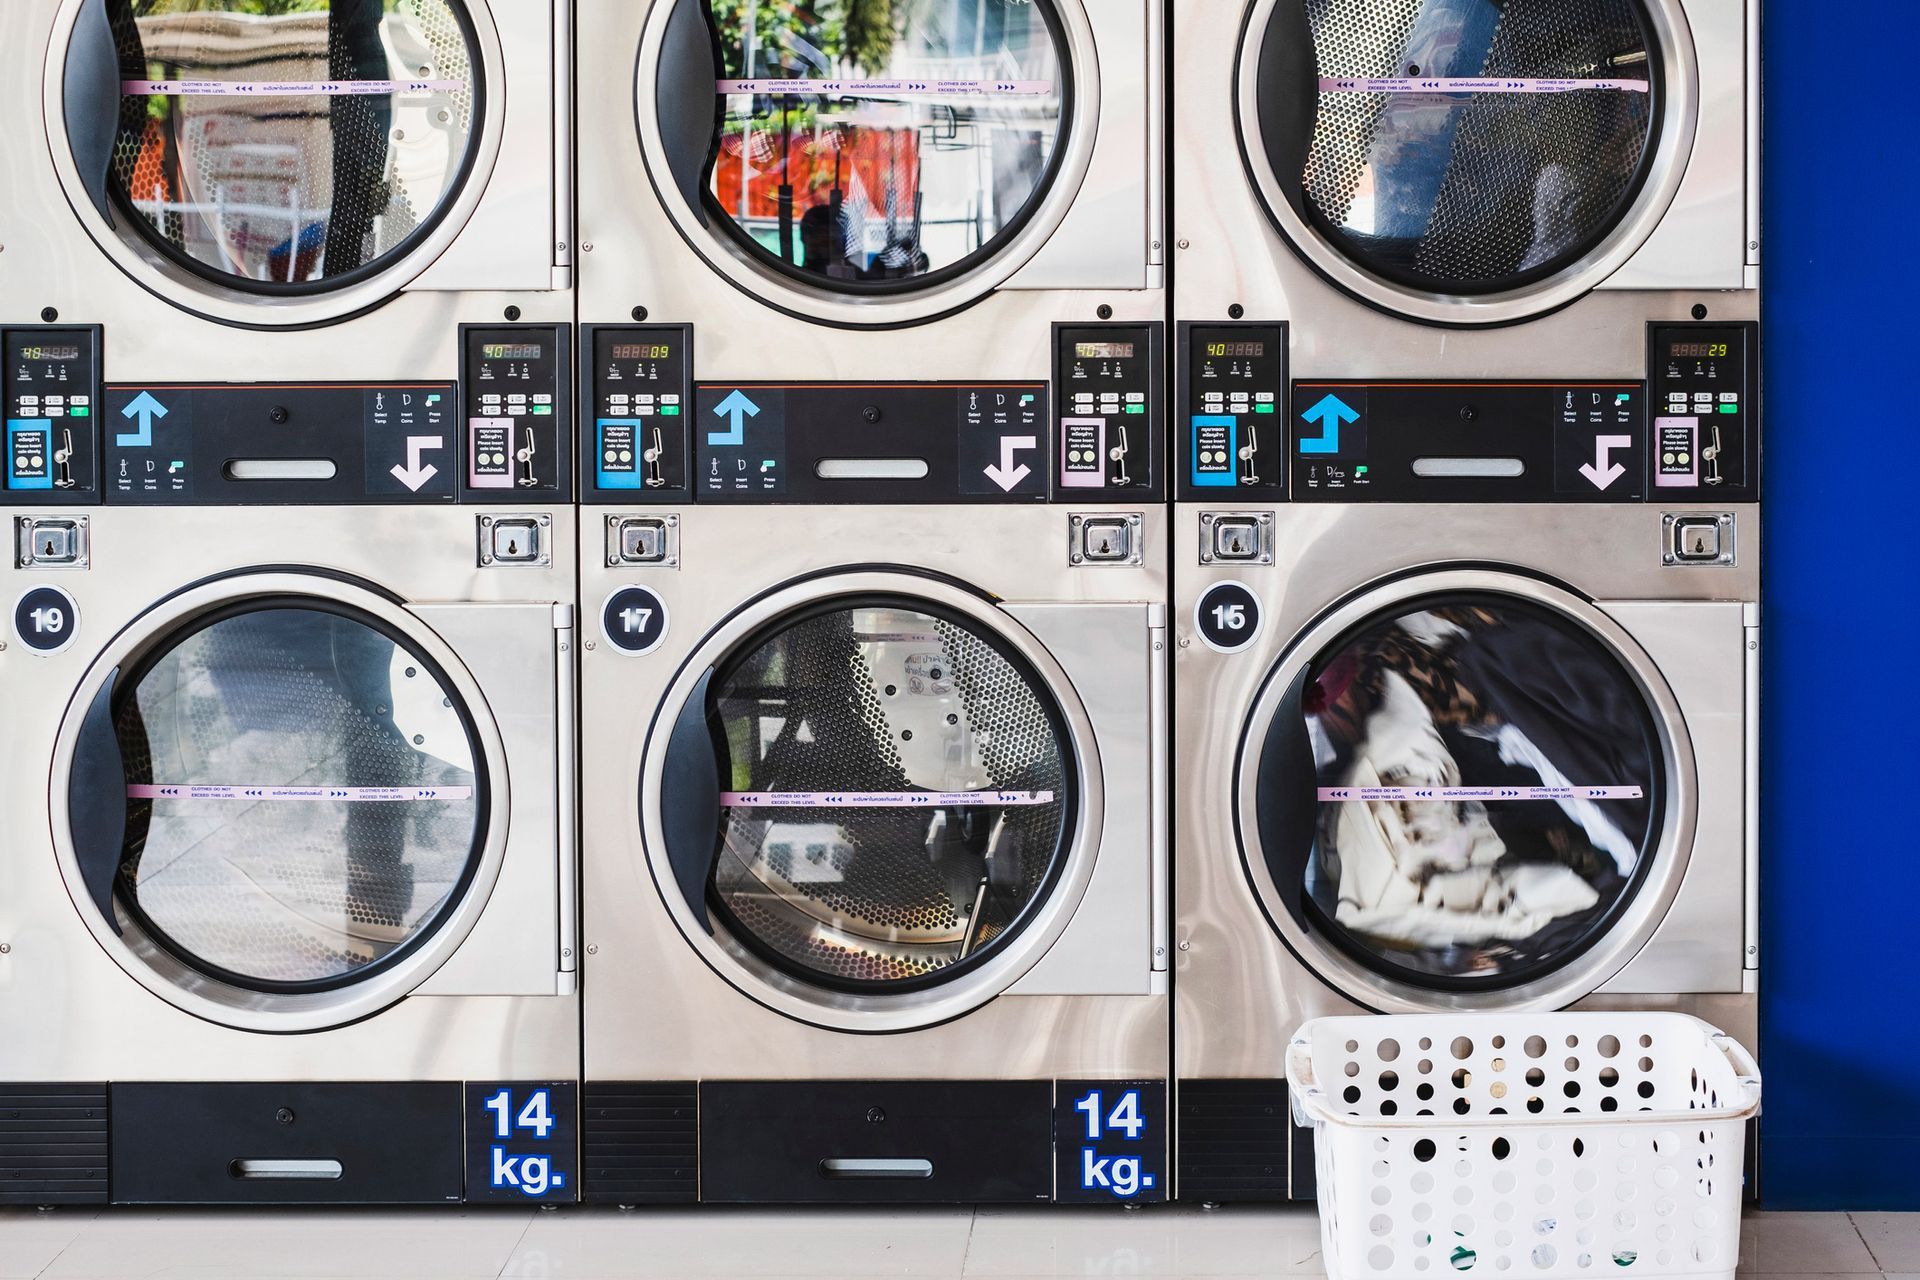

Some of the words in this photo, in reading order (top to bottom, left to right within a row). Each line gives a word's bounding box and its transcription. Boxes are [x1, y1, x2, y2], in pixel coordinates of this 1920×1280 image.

[485, 346, 502, 357] 40
[650, 346, 669, 357] 09
[1207, 344, 1225, 356] 40
[1708, 344, 1726, 356] 29
[30, 607, 64, 633] 19
[618, 607, 652, 633] 17
[1211, 604, 1246, 630] 15
[486, 1090, 554, 1138] 14
[1076, 1091, 1144, 1139] 14
[492, 1146, 563, 1196] kg.
[1082, 1148, 1154, 1197] kg.
